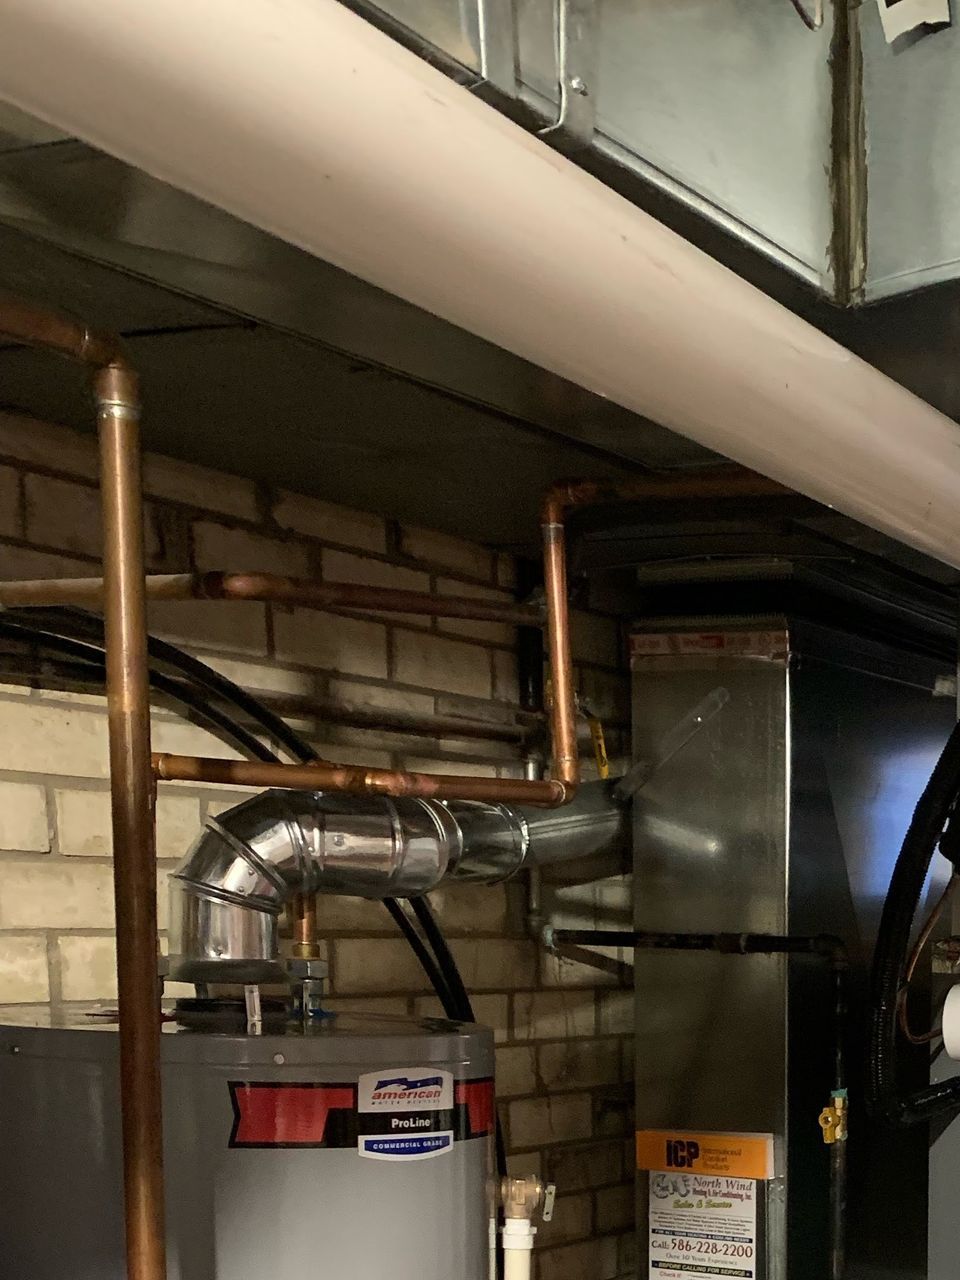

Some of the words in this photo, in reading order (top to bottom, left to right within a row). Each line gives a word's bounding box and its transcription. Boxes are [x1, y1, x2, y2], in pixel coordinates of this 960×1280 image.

[371, 1090, 441, 1100] american
[391, 1117, 431, 1128] ProLine
[372, 1141, 421, 1149] COMMERCIAL
[422, 1139, 443, 1147] GRADE
[666, 1139, 699, 1168] ICP
[692, 1176, 721, 1189] North
[725, 1179, 752, 1191] Wind
[652, 1240, 669, 1249] Call:
[671, 1238, 753, 1258] 586-228-2200
[658, 1262, 681, 1270] BEFORE
[720, 1269, 746, 1277] SERVICE
